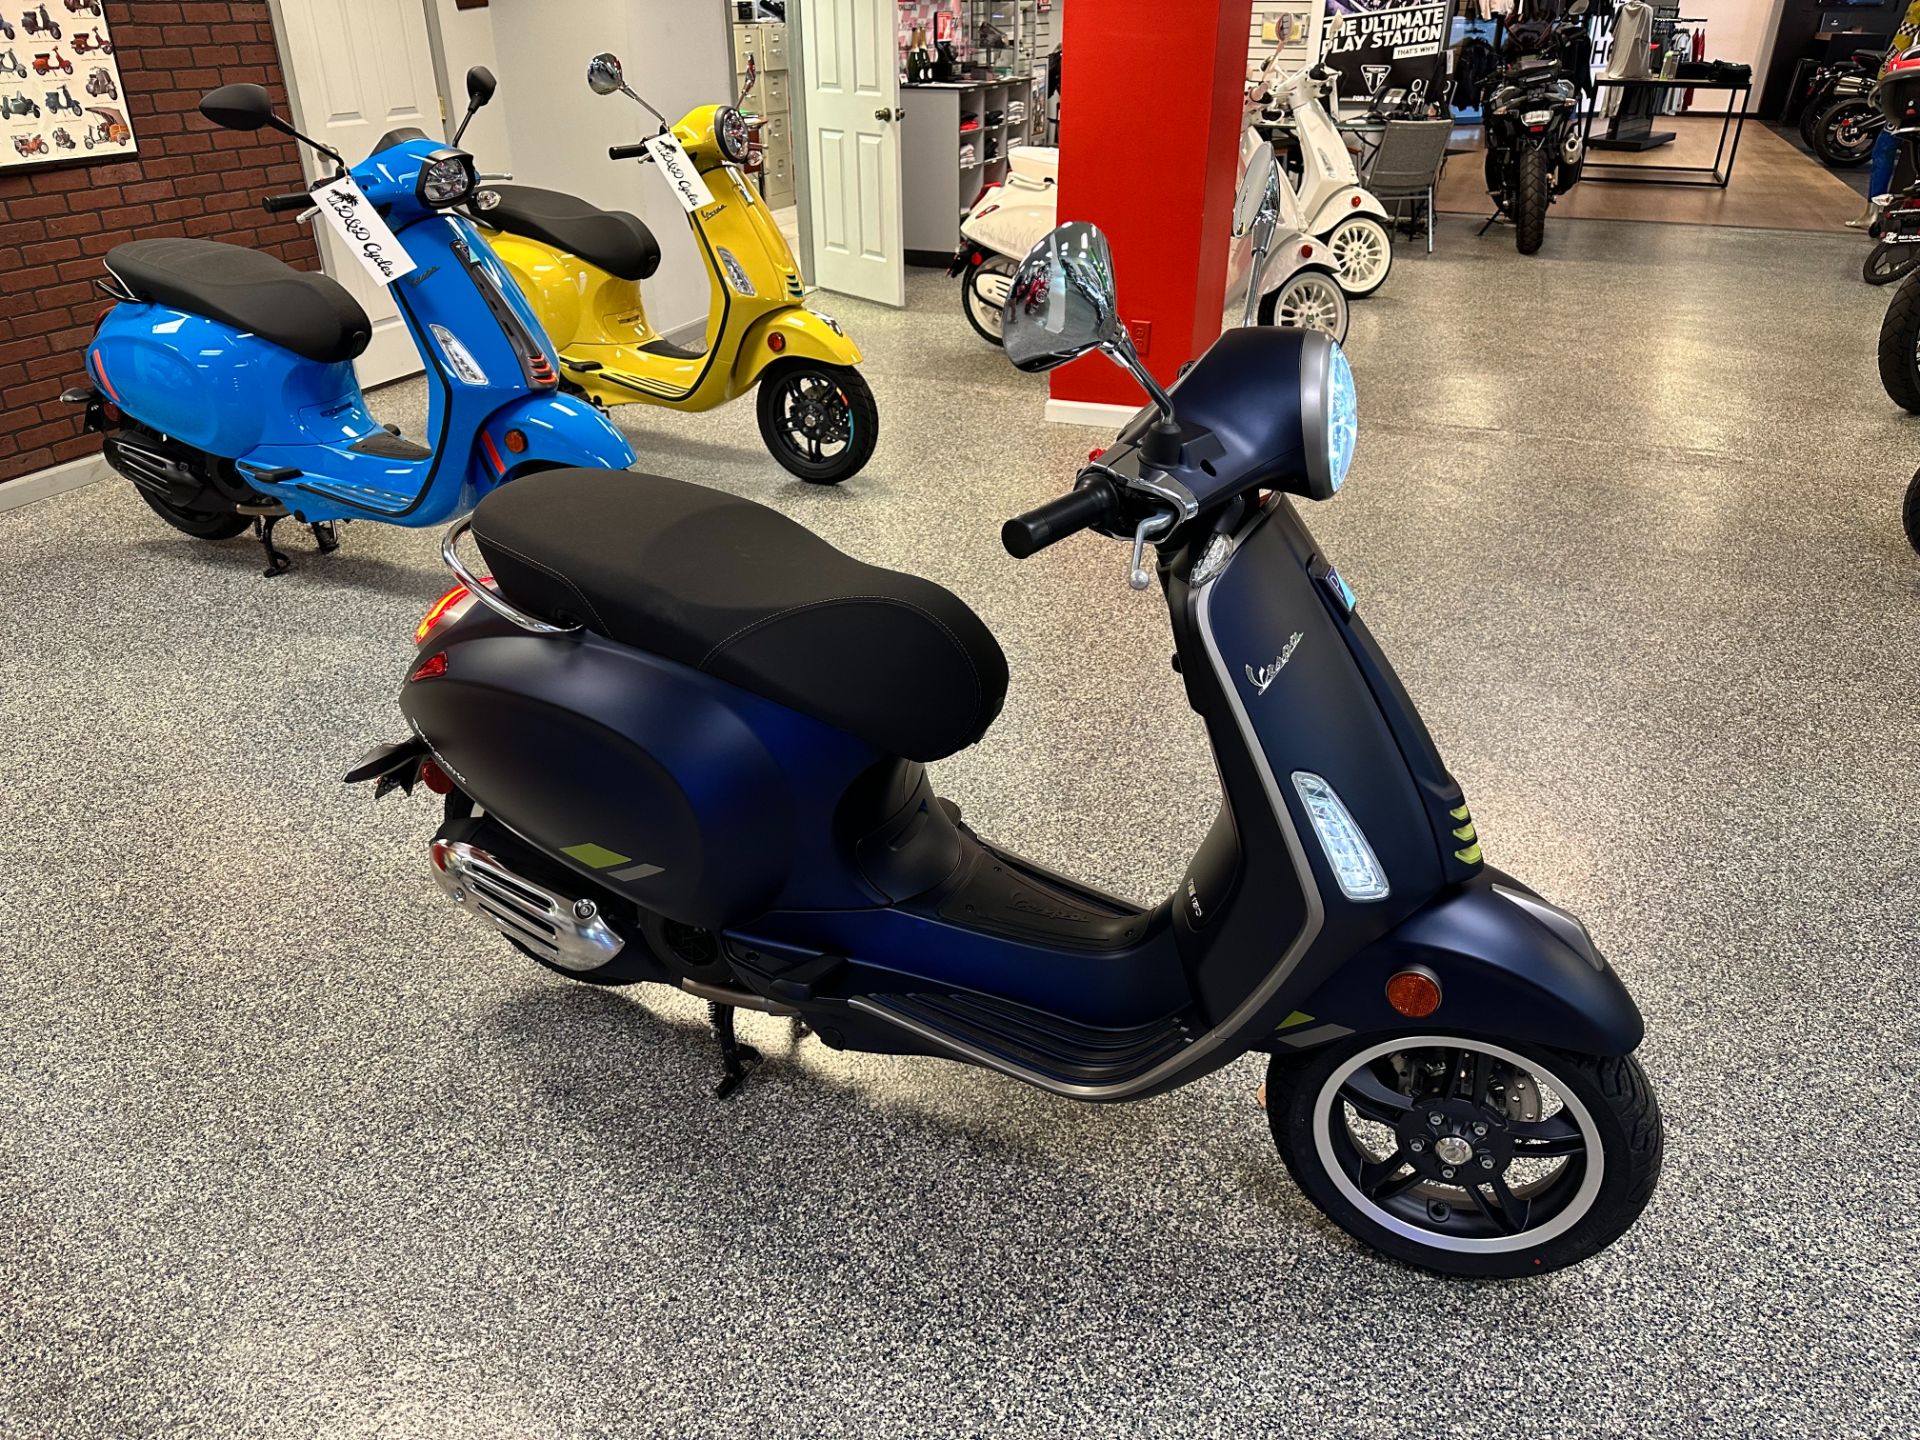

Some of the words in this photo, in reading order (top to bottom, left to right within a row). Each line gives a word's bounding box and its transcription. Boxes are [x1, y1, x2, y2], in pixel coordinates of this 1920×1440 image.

[1320, 33, 1369, 54] PLAY
[1370, 24, 1442, 49] STATION
[1323, 19, 1357, 39] THE
[1361, 7, 1445, 34] ULTIMATE
[1397, 47, 1418, 56] THAT'S
[334, 205, 371, 241] D&D
[363, 242, 394, 278] Cycles
[1244, 631, 1304, 696] Vespa
